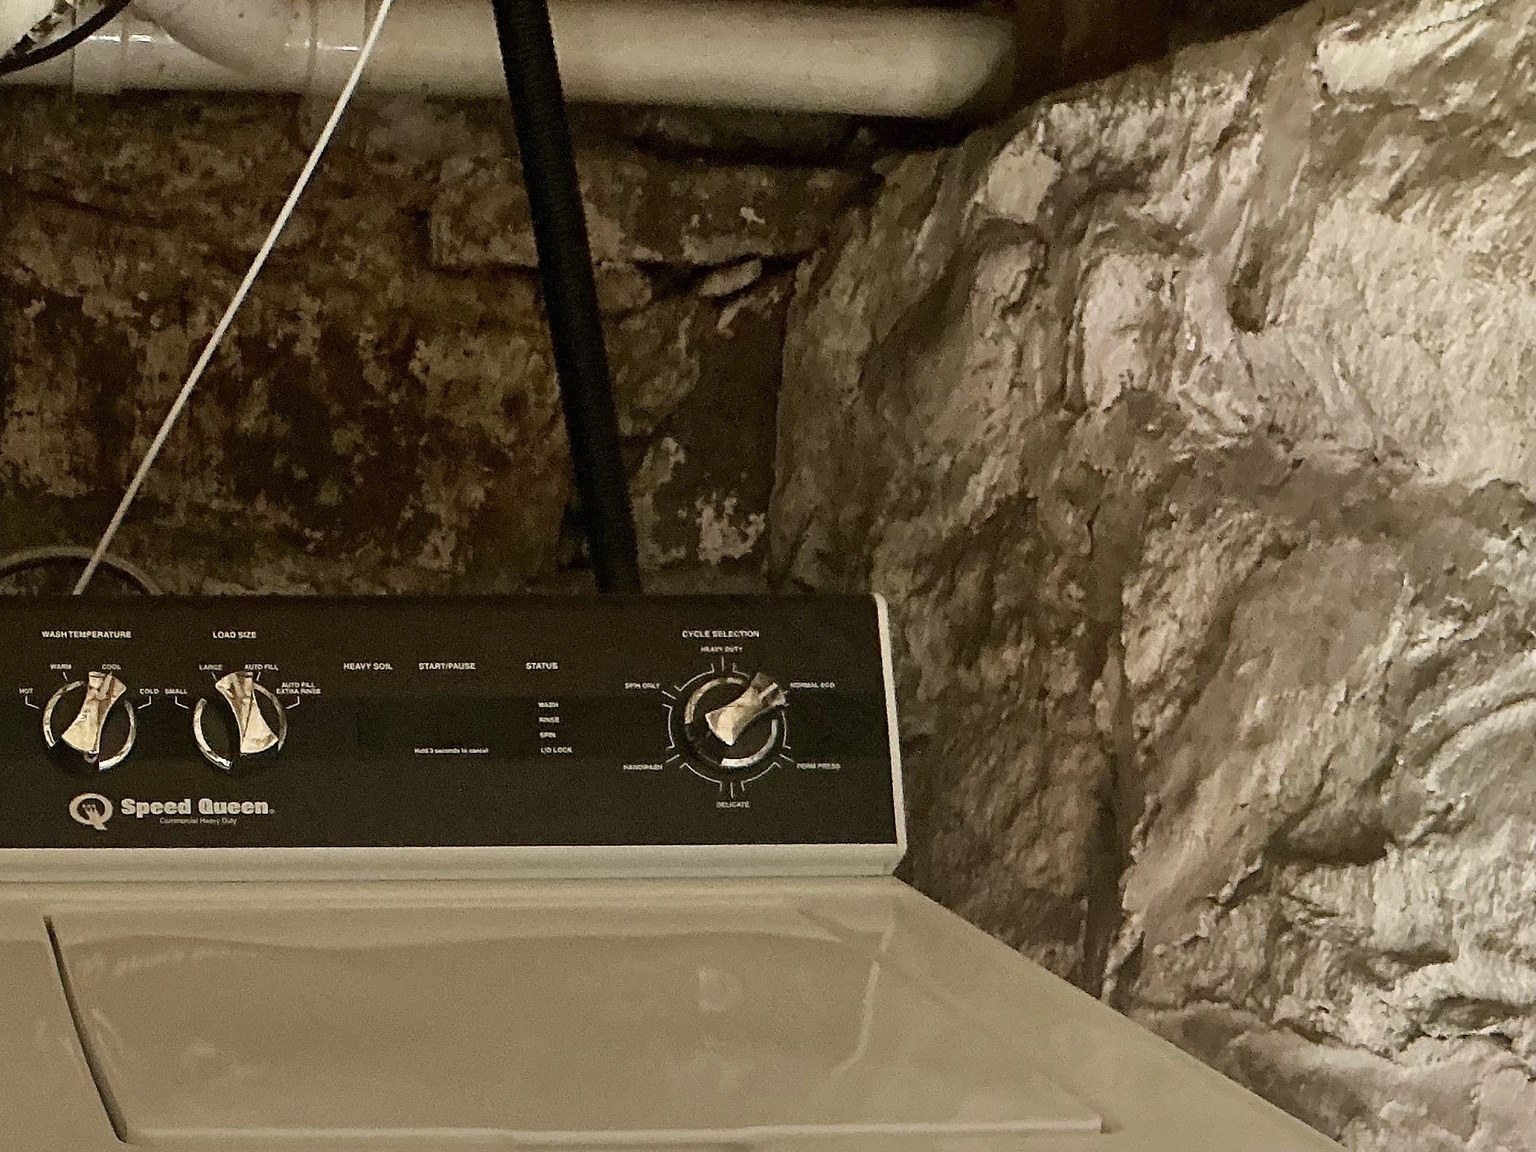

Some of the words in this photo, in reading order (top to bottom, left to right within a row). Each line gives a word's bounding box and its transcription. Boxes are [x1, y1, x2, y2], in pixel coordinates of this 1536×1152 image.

[42, 631, 67, 639] WASH
[68, 630, 132, 639] TEMPERATURE
[212, 631, 237, 639] LOAD
[238, 631, 257, 639] SIZE
[682, 630, 710, 638] CYCLE
[712, 630, 760, 638] SELECTION
[343, 662, 372, 671] HEAVY
[373, 662, 393, 671] SOIL
[418, 662, 476, 671] START/PAUSE
[526, 662, 559, 670] STATUS
[121, 798, 192, 818] Speed
[716, 801, 750, 809] DELICATE
